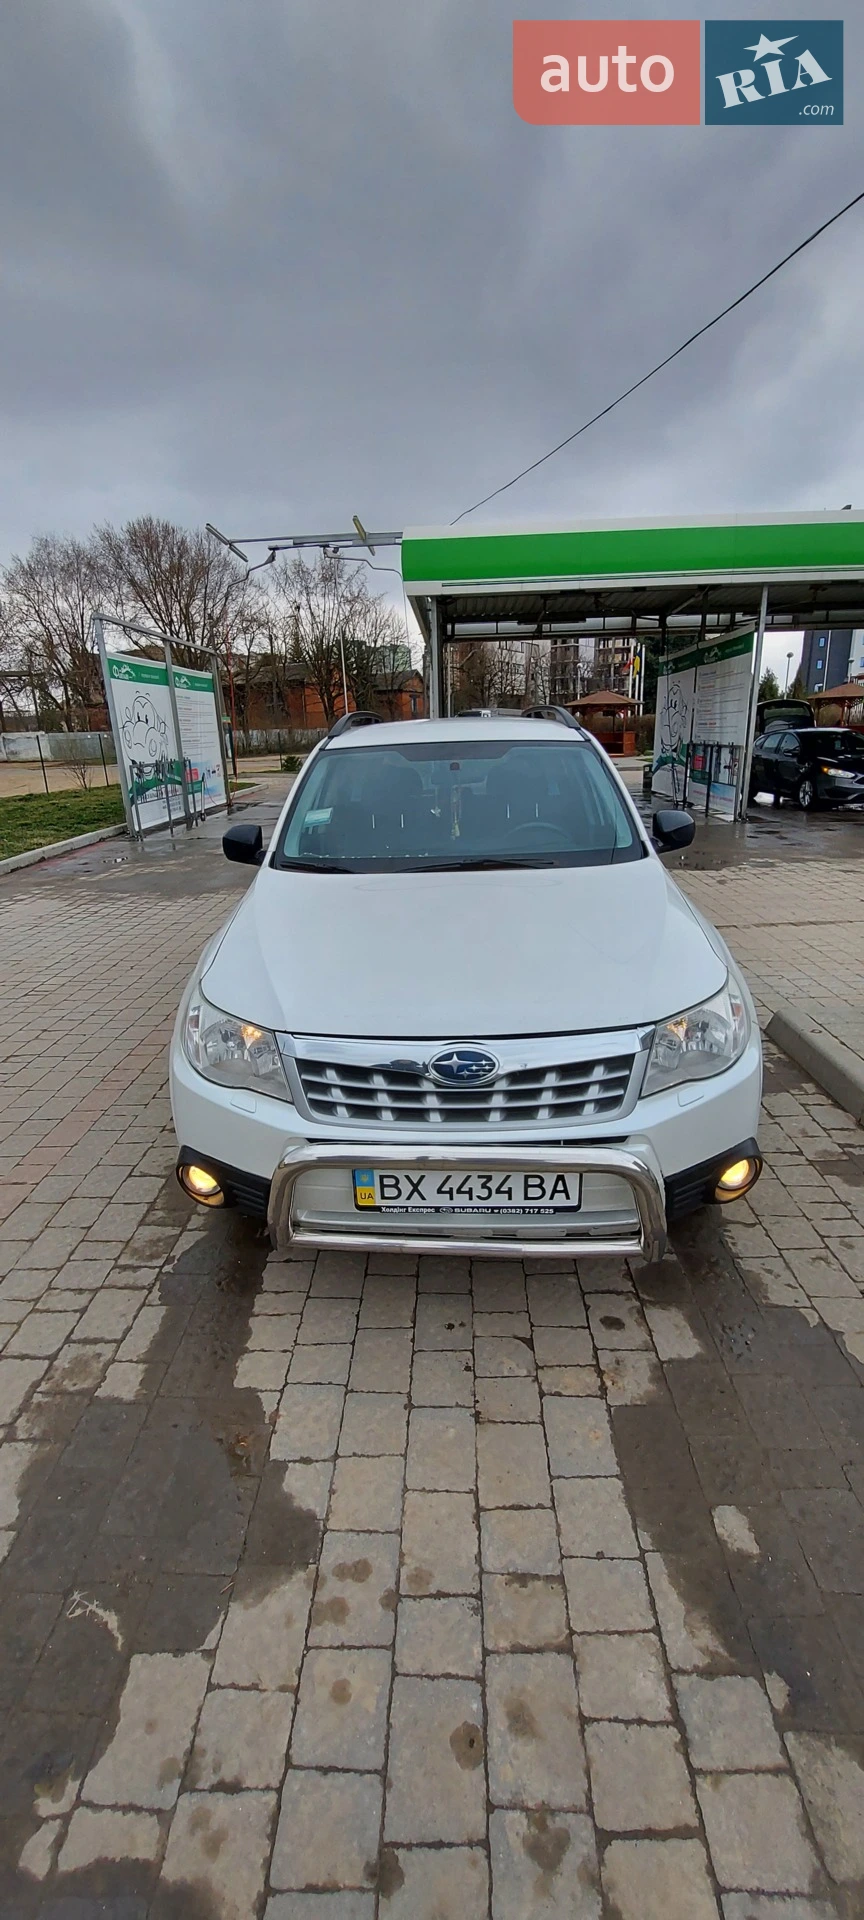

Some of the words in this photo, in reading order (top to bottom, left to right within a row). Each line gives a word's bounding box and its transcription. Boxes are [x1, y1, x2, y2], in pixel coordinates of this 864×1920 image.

[378, 1174, 427, 1201] BX
[436, 1174, 513, 1201] 4434
[523, 1174, 571, 1201] BA
[360, 1192, 374, 1200] UA
[408, 1206, 435, 1214] Експрес
